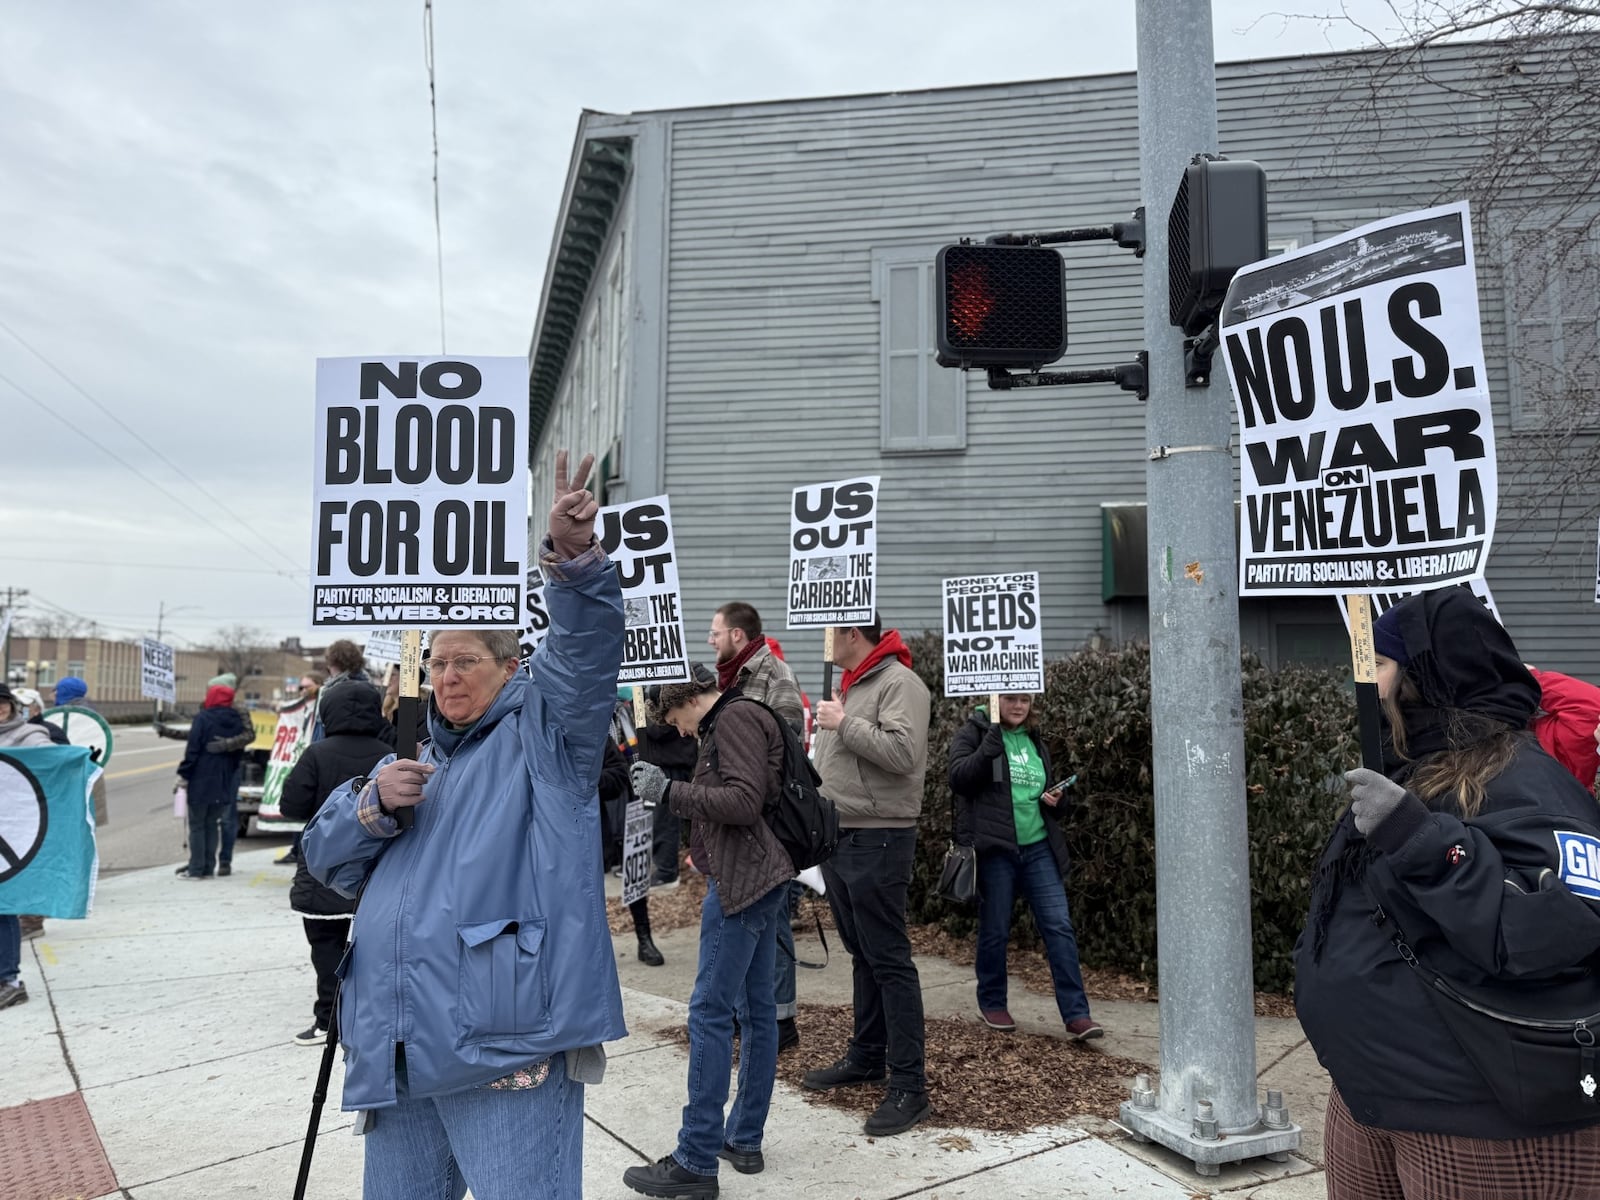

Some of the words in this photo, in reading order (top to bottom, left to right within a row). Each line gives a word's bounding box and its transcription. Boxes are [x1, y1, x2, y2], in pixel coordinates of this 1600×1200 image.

[1226, 316, 1316, 428] NO
[1320, 282, 1476, 411] U.S.
[360, 361, 482, 400] NO
[325, 404, 516, 485] BLOOD
[1246, 408, 1485, 487] WAR
[1324, 469, 1364, 486] ON
[794, 482, 873, 524] US
[1246, 468, 1486, 553] VENEZUELA
[317, 500, 420, 576] FOR
[433, 500, 519, 576] OIL
[793, 520, 873, 552] OUT
[616, 552, 672, 589] UT
[792, 558, 806, 582] OF
[850, 553, 872, 577] THE
[946, 576, 1000, 587] MONEY
[1004, 574, 1035, 582] FOR
[1248, 564, 1284, 583] PARTY
[1285, 563, 1312, 582] FOR
[1312, 559, 1374, 582] SOCIALISM
[1376, 560, 1396, 580] &
[1396, 548, 1478, 579] LIBERATION
[316, 588, 352, 605] PARTY
[352, 588, 374, 604] FOR
[374, 588, 432, 604] SOCIALISM
[435, 588, 450, 604] &
[451, 587, 516, 604] LIBERATION
[790, 578, 872, 610] CARIBBEAN
[946, 582, 1035, 596] PEOPLE'S
[316, 606, 515, 622] PSLWEB.ORG
[650, 592, 678, 624] THE
[804, 613, 812, 622] FOR
[813, 612, 837, 622] SOCIALISM
[837, 612, 844, 621] &
[844, 610, 870, 621] LIBERATION
[947, 592, 1036, 634] NEEDS
[622, 624, 682, 663] BBEAN
[948, 636, 1015, 653] NOT
[144, 647, 172, 672] NEEDS
[144, 667, 167, 679] NOT
[646, 667, 654, 678] &
[654, 664, 684, 677] LIBERATION
[948, 654, 978, 673] WAR
[980, 652, 1040, 672] MACHINE
[949, 681, 1039, 692] PSLWEB.ORG
[1001, 673, 1008, 682] &
[1009, 673, 1038, 681] LIBERATION
